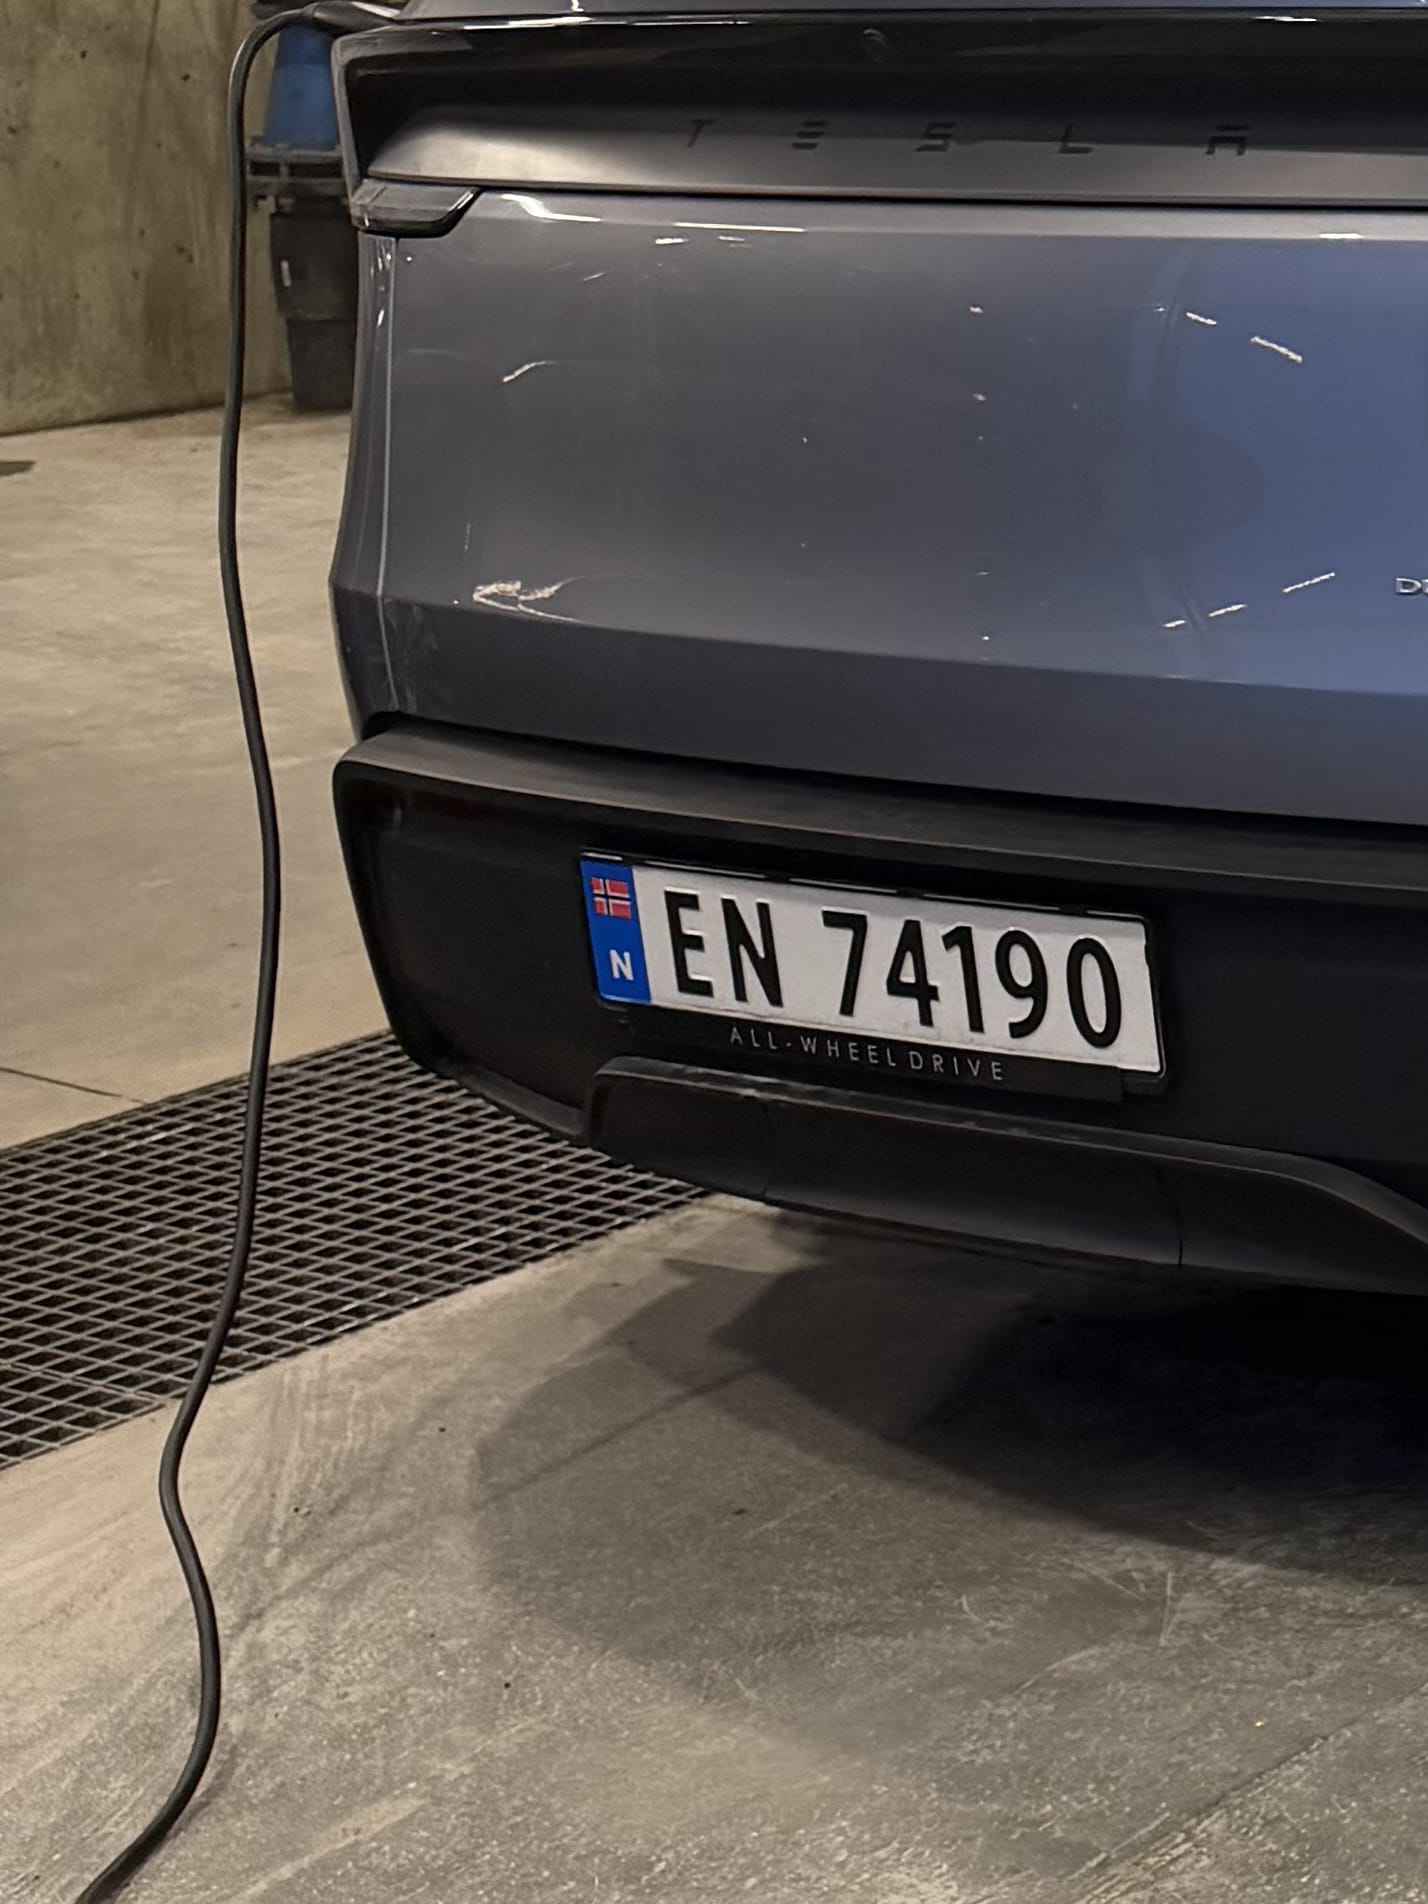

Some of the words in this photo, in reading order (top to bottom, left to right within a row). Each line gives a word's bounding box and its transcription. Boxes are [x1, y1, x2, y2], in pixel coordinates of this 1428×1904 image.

[687, 119, 1251, 156] TESLA
[610, 949, 634, 981] N
[663, 888, 783, 1007] EN
[821, 907, 1122, 1049] 74190
